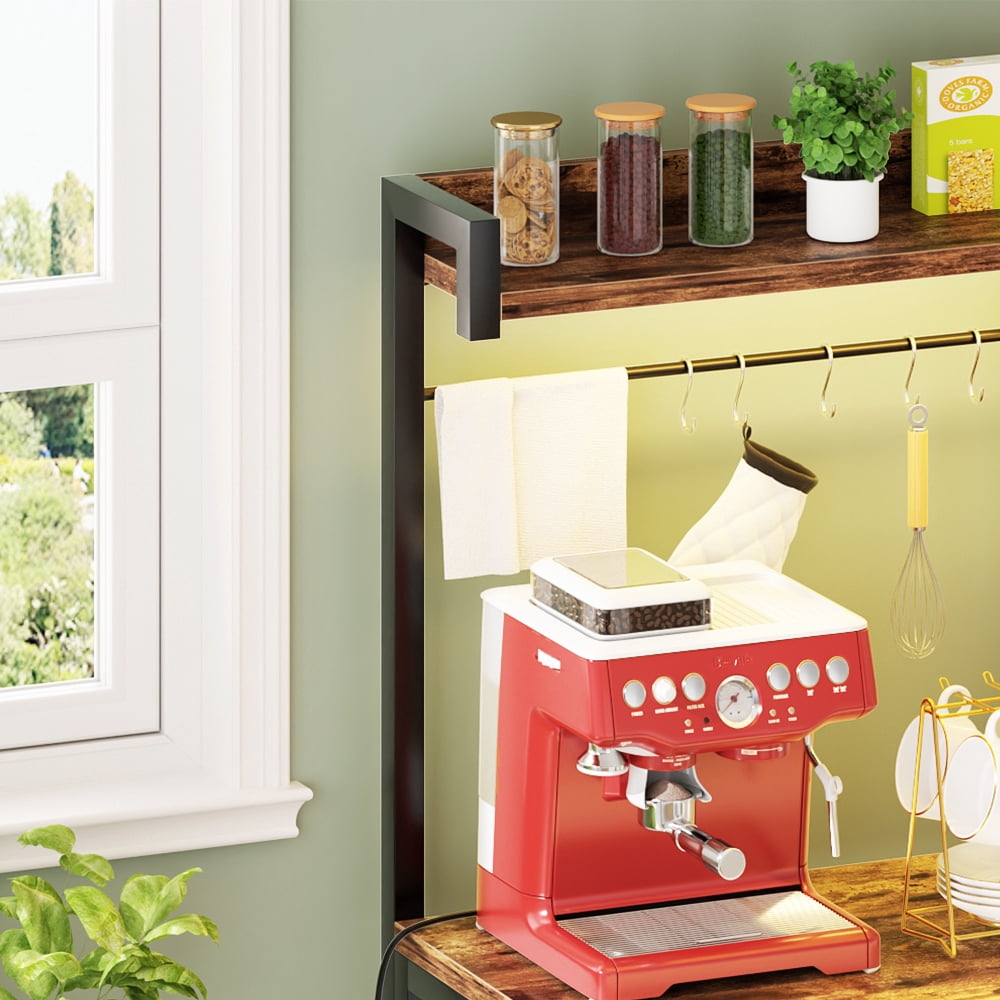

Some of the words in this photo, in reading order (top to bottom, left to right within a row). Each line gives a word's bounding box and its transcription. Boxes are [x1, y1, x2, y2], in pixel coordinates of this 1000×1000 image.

[942, 78, 965, 104] DOVES
[966, 77, 990, 91] FARM
[947, 92, 990, 111] ORGANIC
